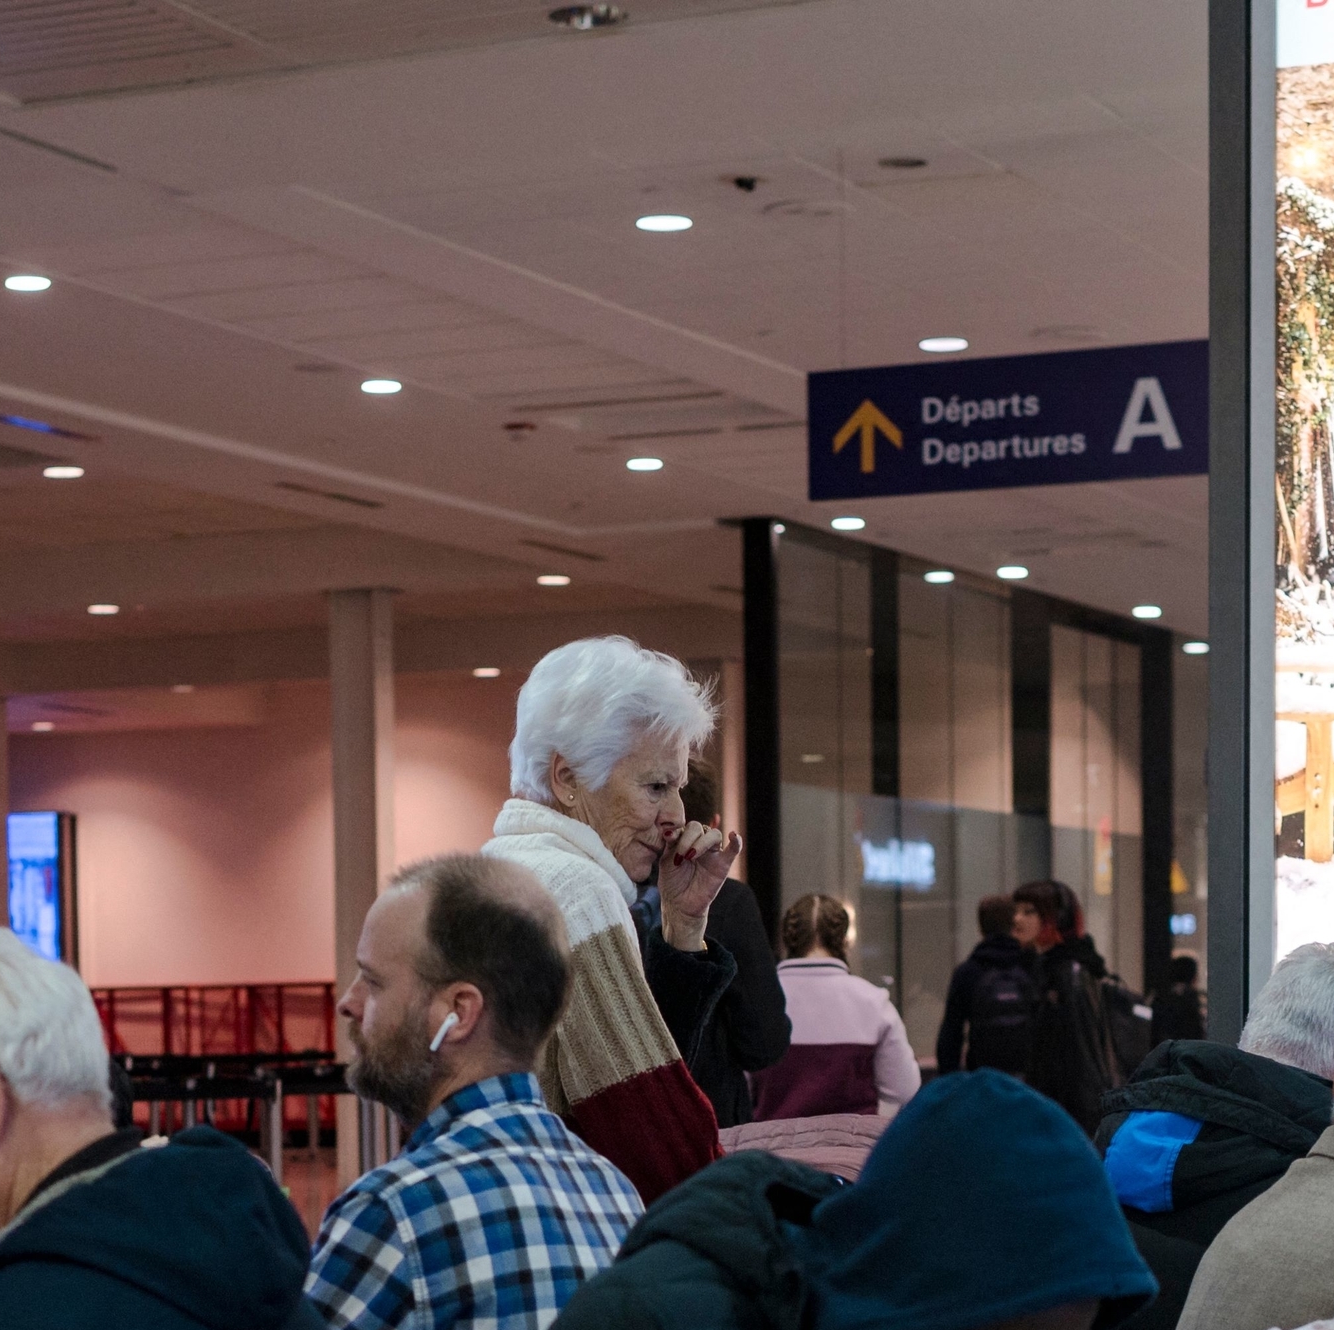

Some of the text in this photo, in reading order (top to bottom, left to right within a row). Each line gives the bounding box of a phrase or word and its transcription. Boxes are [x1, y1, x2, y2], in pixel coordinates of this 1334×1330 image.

[921, 393, 1040, 427] Départs
[1112, 376, 1183, 454] A
[921, 431, 1087, 468] Departures
